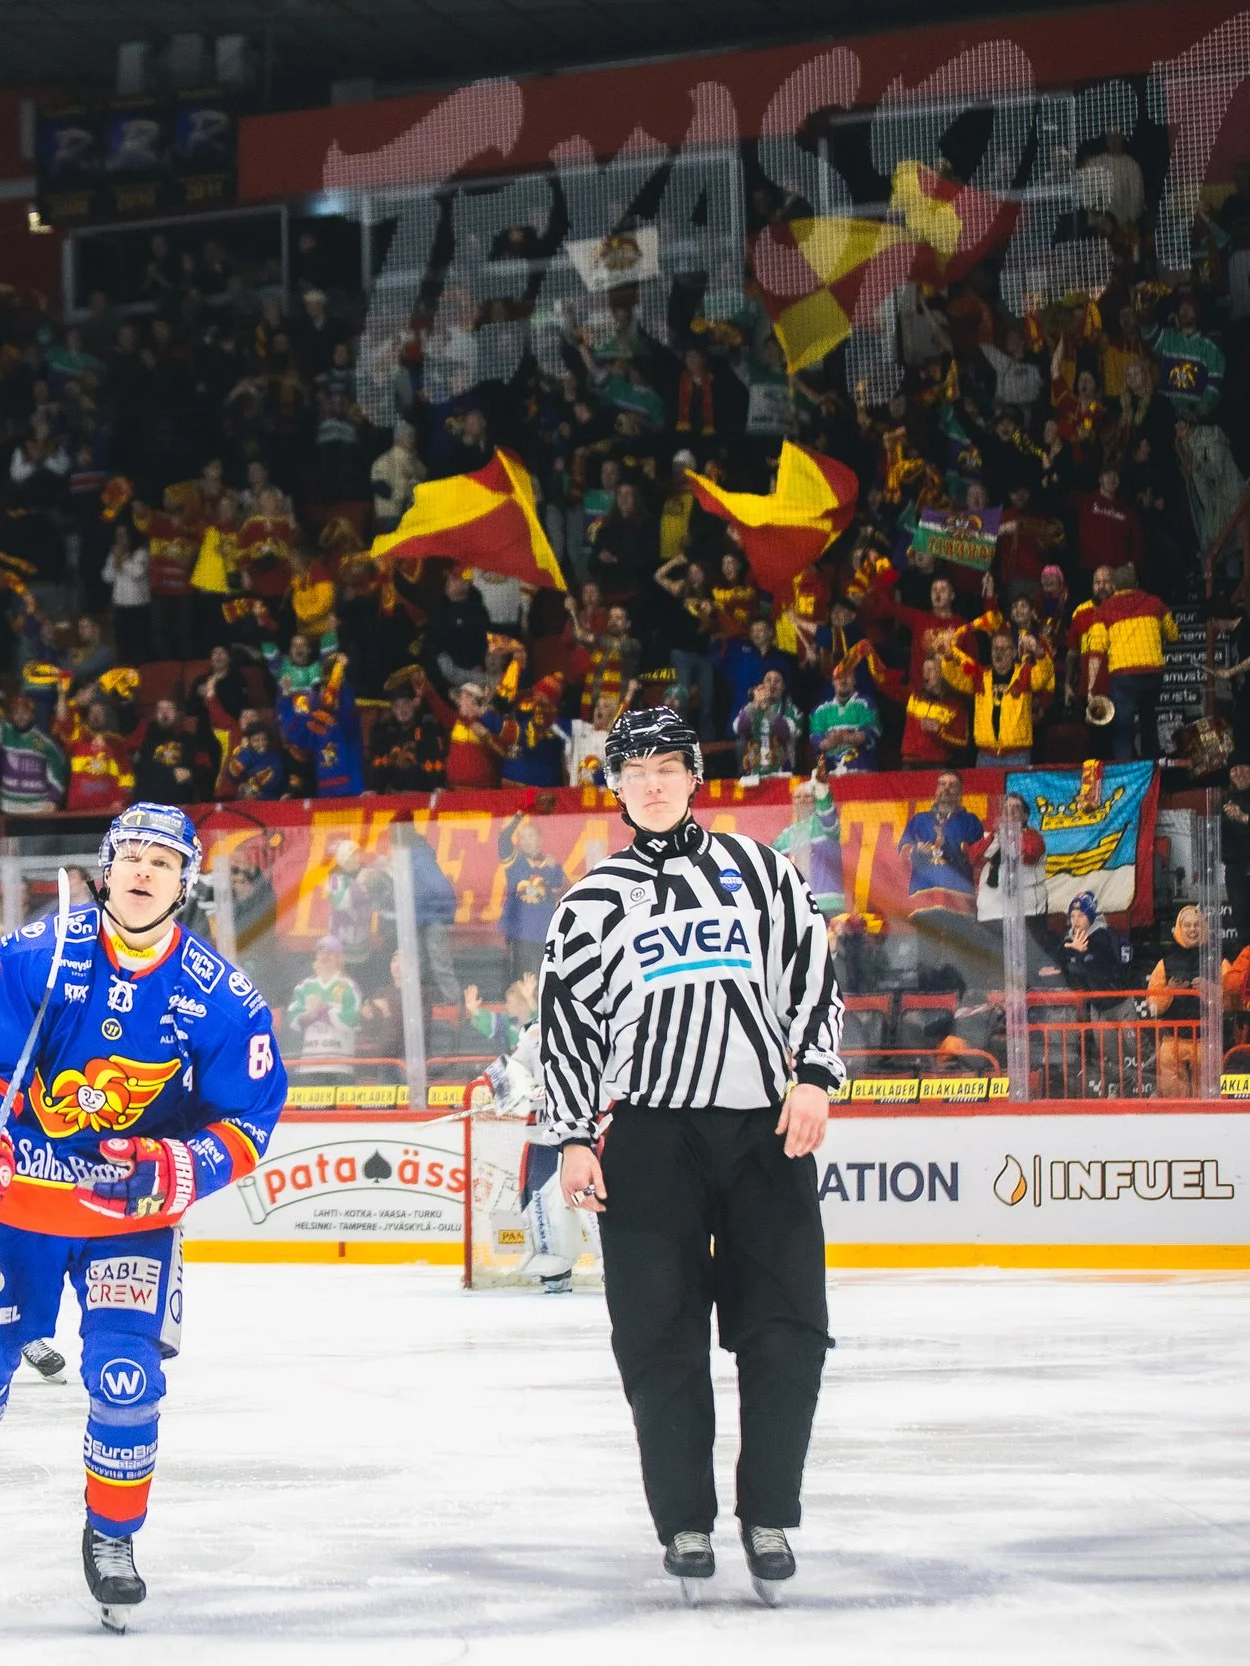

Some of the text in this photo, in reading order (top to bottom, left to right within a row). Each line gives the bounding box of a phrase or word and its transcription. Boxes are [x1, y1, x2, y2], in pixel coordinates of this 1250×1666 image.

[633, 919, 750, 968] SVEA
[263, 1152, 357, 1205] pata
[397, 1148, 466, 1194] äss
[1050, 1159, 1235, 1200] INFUEL
[313, 1209, 442, 1218] LAHTI KOTKA VAASA TURKU
[294, 1222, 332, 1231] HELSINKI
[338, 1222, 377, 1231] TAMPERE
[437, 1223, 462, 1232] OULU
[88, 1262, 159, 1285] CABLE
[89, 1284, 153, 1304] CREW
[104, 1370, 142, 1395] W
